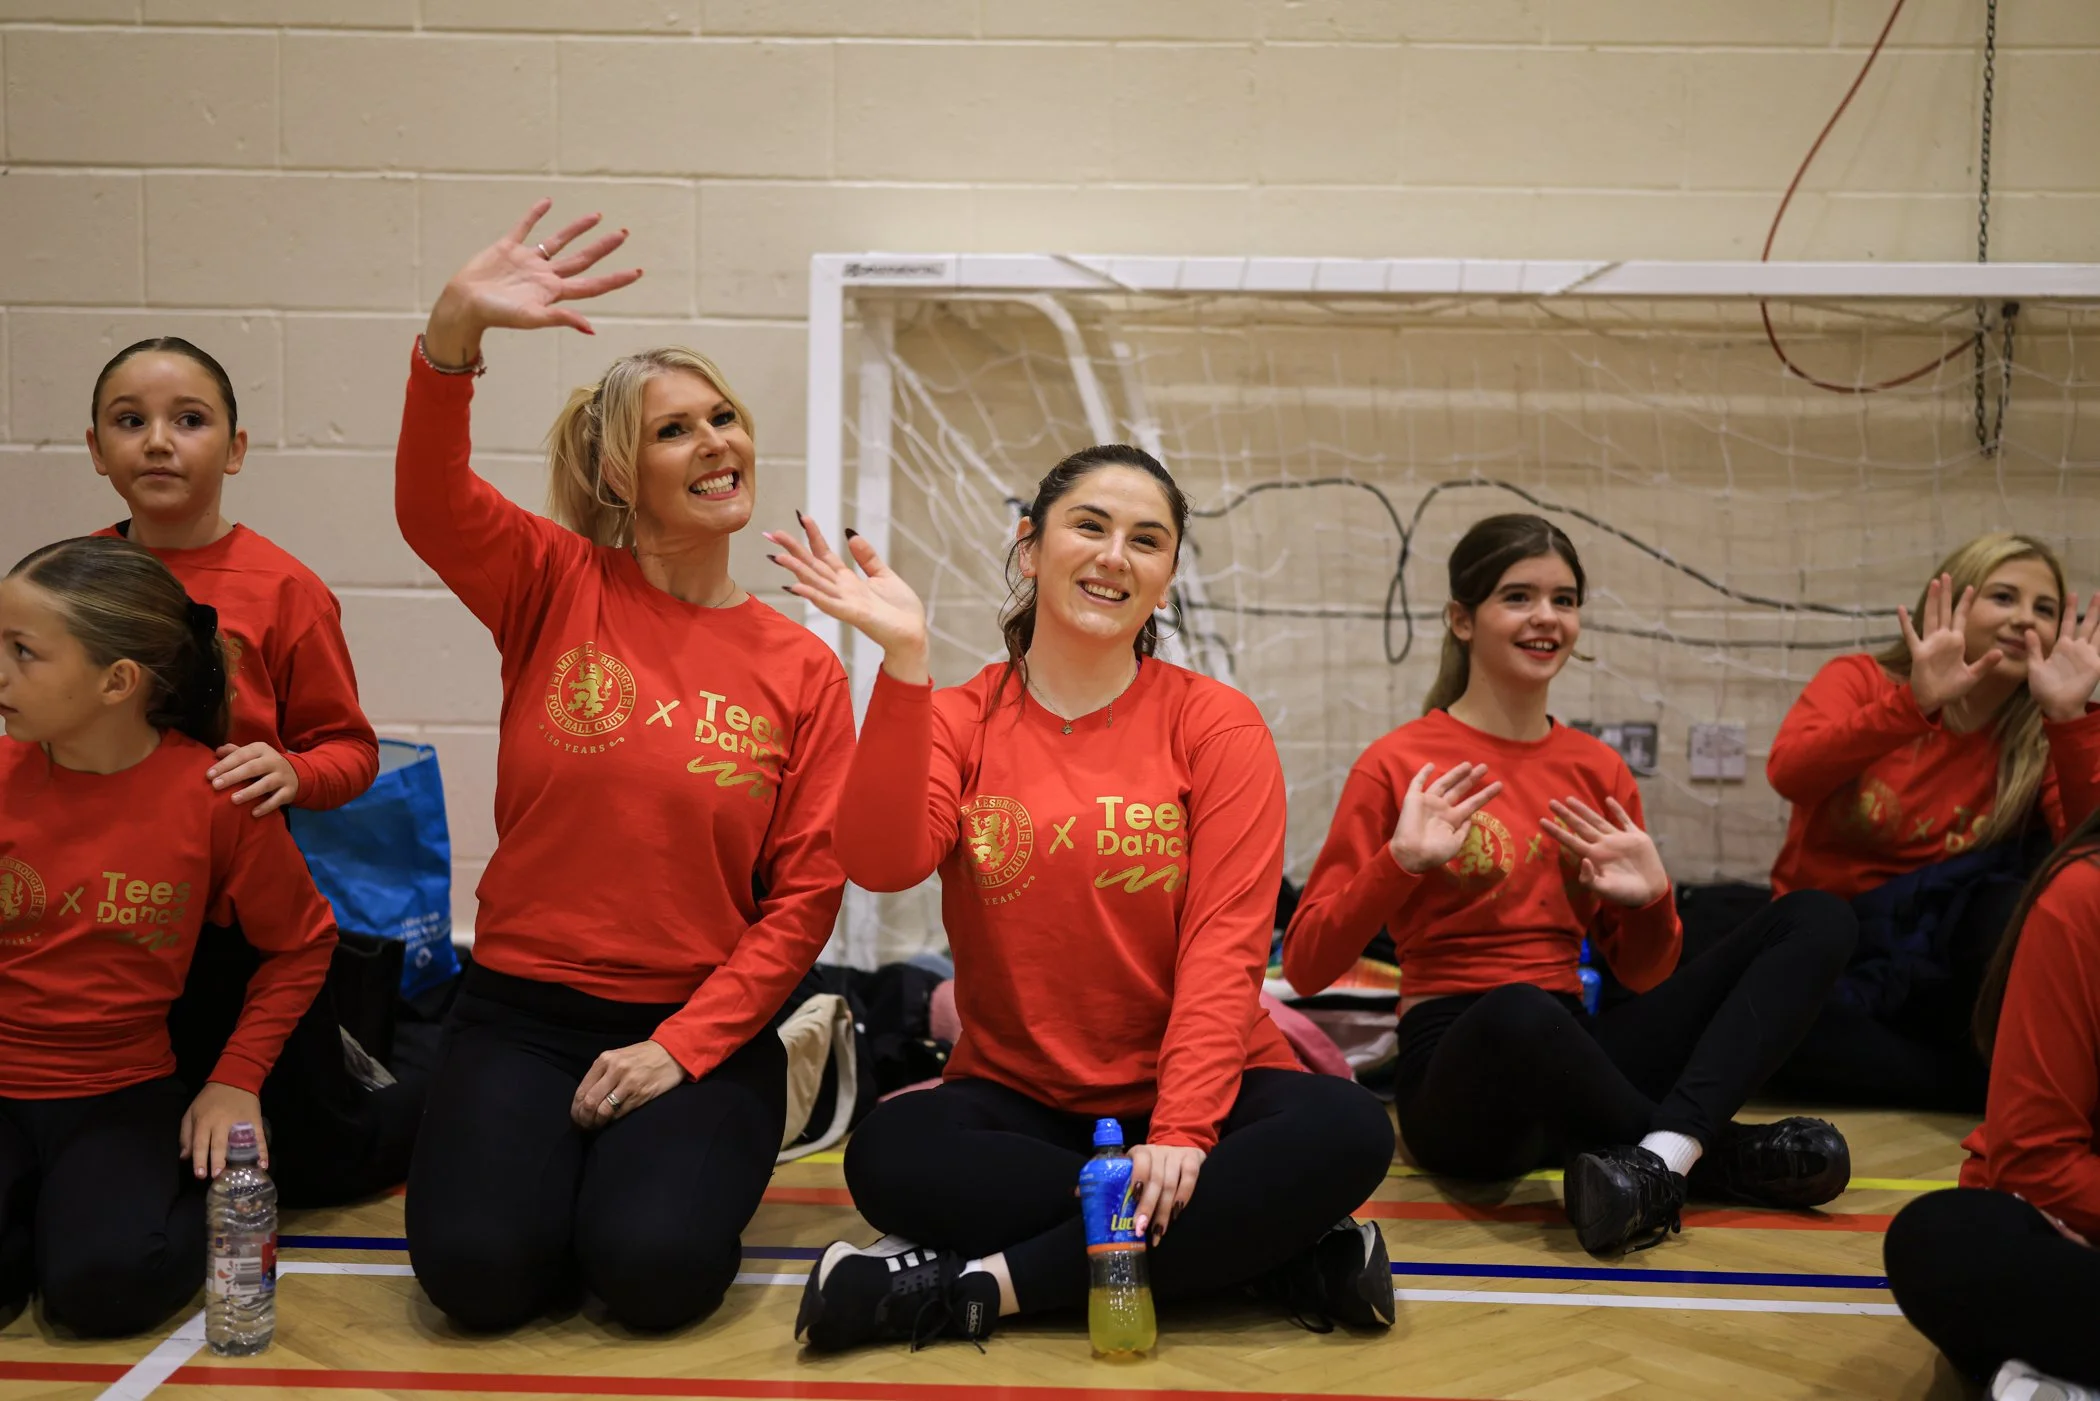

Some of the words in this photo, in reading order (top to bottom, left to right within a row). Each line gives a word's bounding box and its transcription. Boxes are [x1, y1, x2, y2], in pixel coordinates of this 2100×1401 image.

[547, 693, 593, 733] FOOTBALL
[594, 712, 625, 732] CLUB
[564, 743, 606, 754] YEARS
[1003, 849, 1028, 878] CLUB
[102, 871, 192, 904] Tees
[96, 901, 186, 925] Dance
